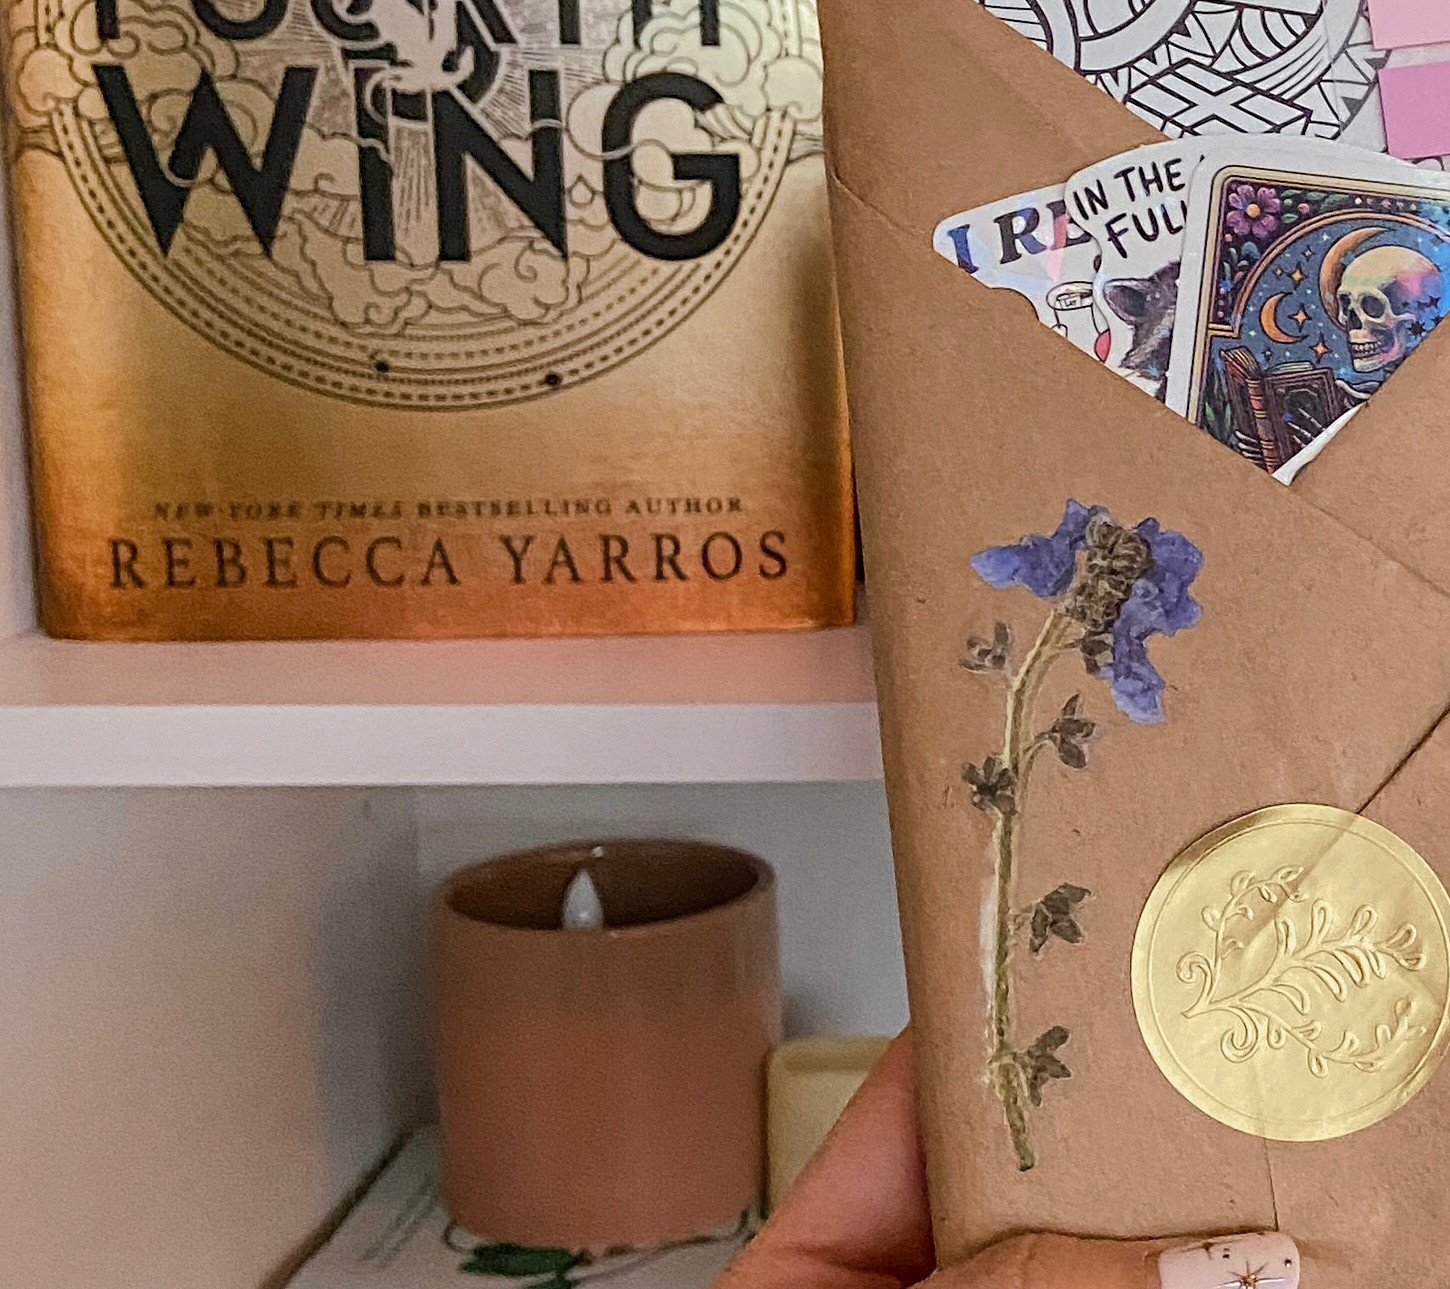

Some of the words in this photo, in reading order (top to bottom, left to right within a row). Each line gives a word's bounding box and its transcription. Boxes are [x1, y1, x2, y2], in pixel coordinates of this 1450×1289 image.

[91, 64, 743, 262] WING
[1072, 178, 1110, 221] IN
[1113, 157, 1186, 203] THE
[154, 498, 220, 521] NEW
[227, 499, 302, 521] YORK
[313, 498, 401, 520] TIMES
[416, 496, 614, 520] BESTSELLING
[623, 495, 745, 516] AUTHOR
[108, 533, 462, 592] REBECCA
[500, 527, 793, 586] YARROS
